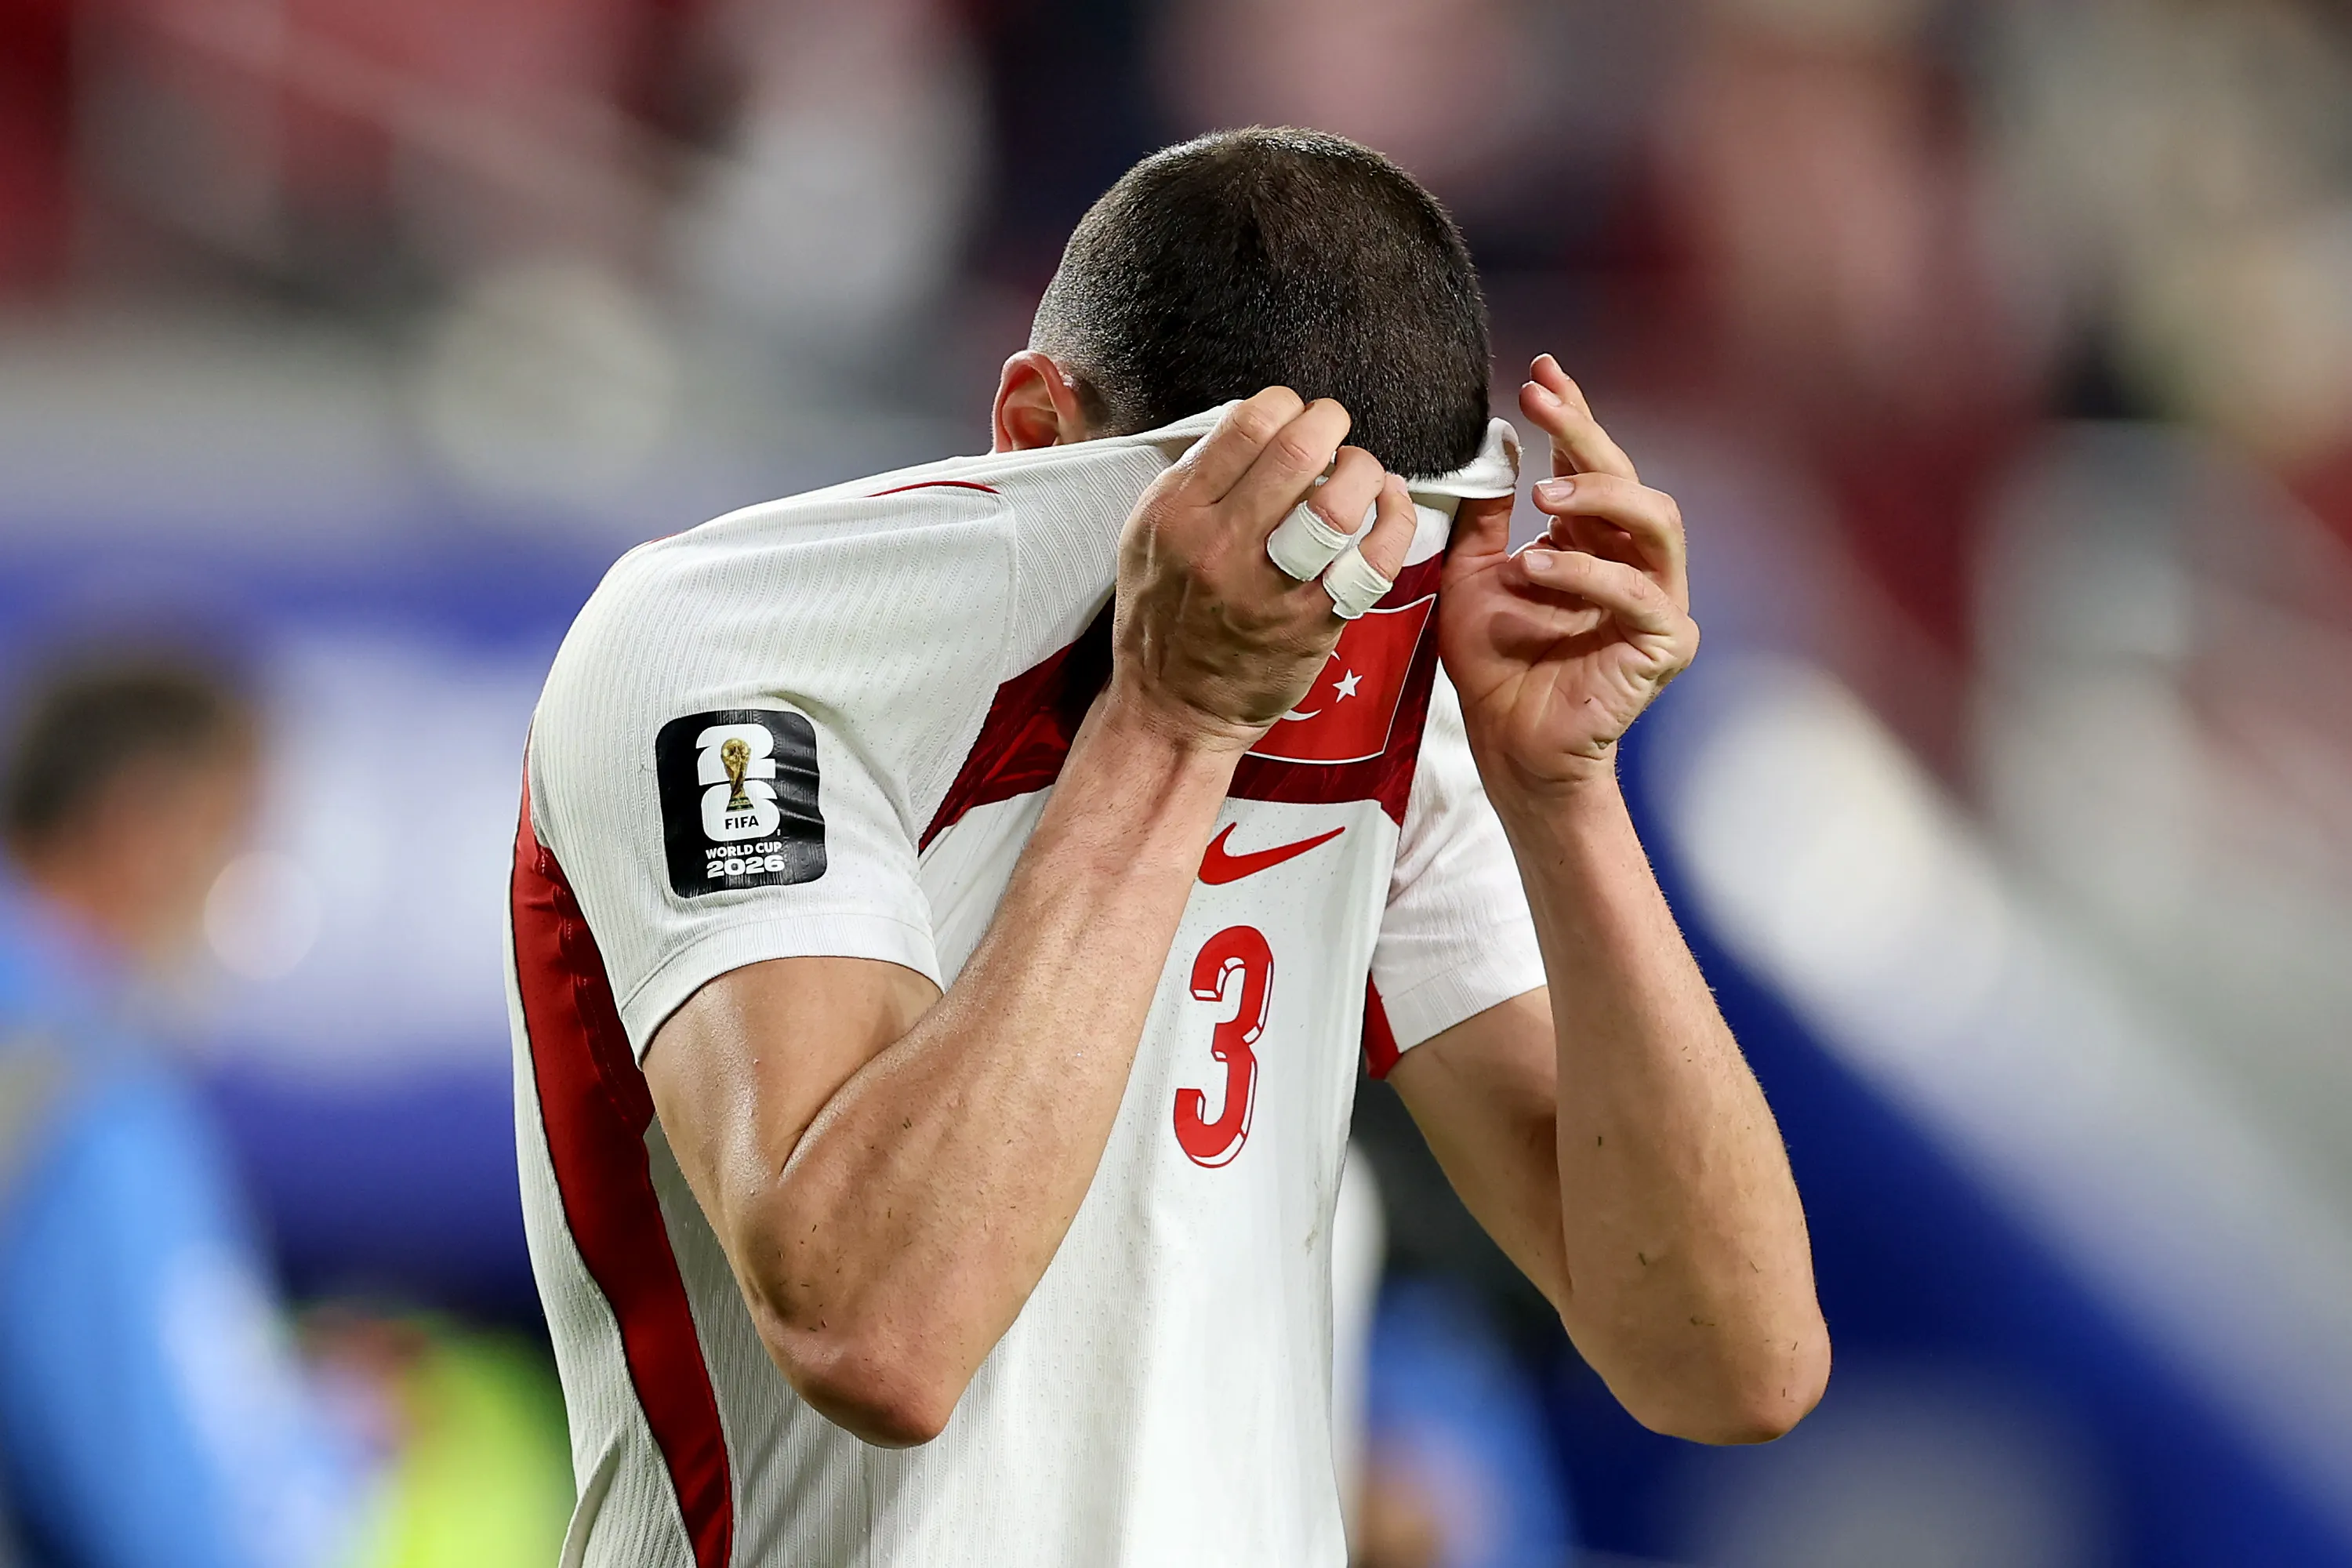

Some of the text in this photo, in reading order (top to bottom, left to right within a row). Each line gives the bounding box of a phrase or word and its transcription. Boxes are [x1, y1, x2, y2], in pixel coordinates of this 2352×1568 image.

[724, 815, 759, 829] FIFA
[706, 841, 782, 859] WORLD CUP
[706, 855, 786, 879] 2026
[1174, 925, 1274, 1168] 3
